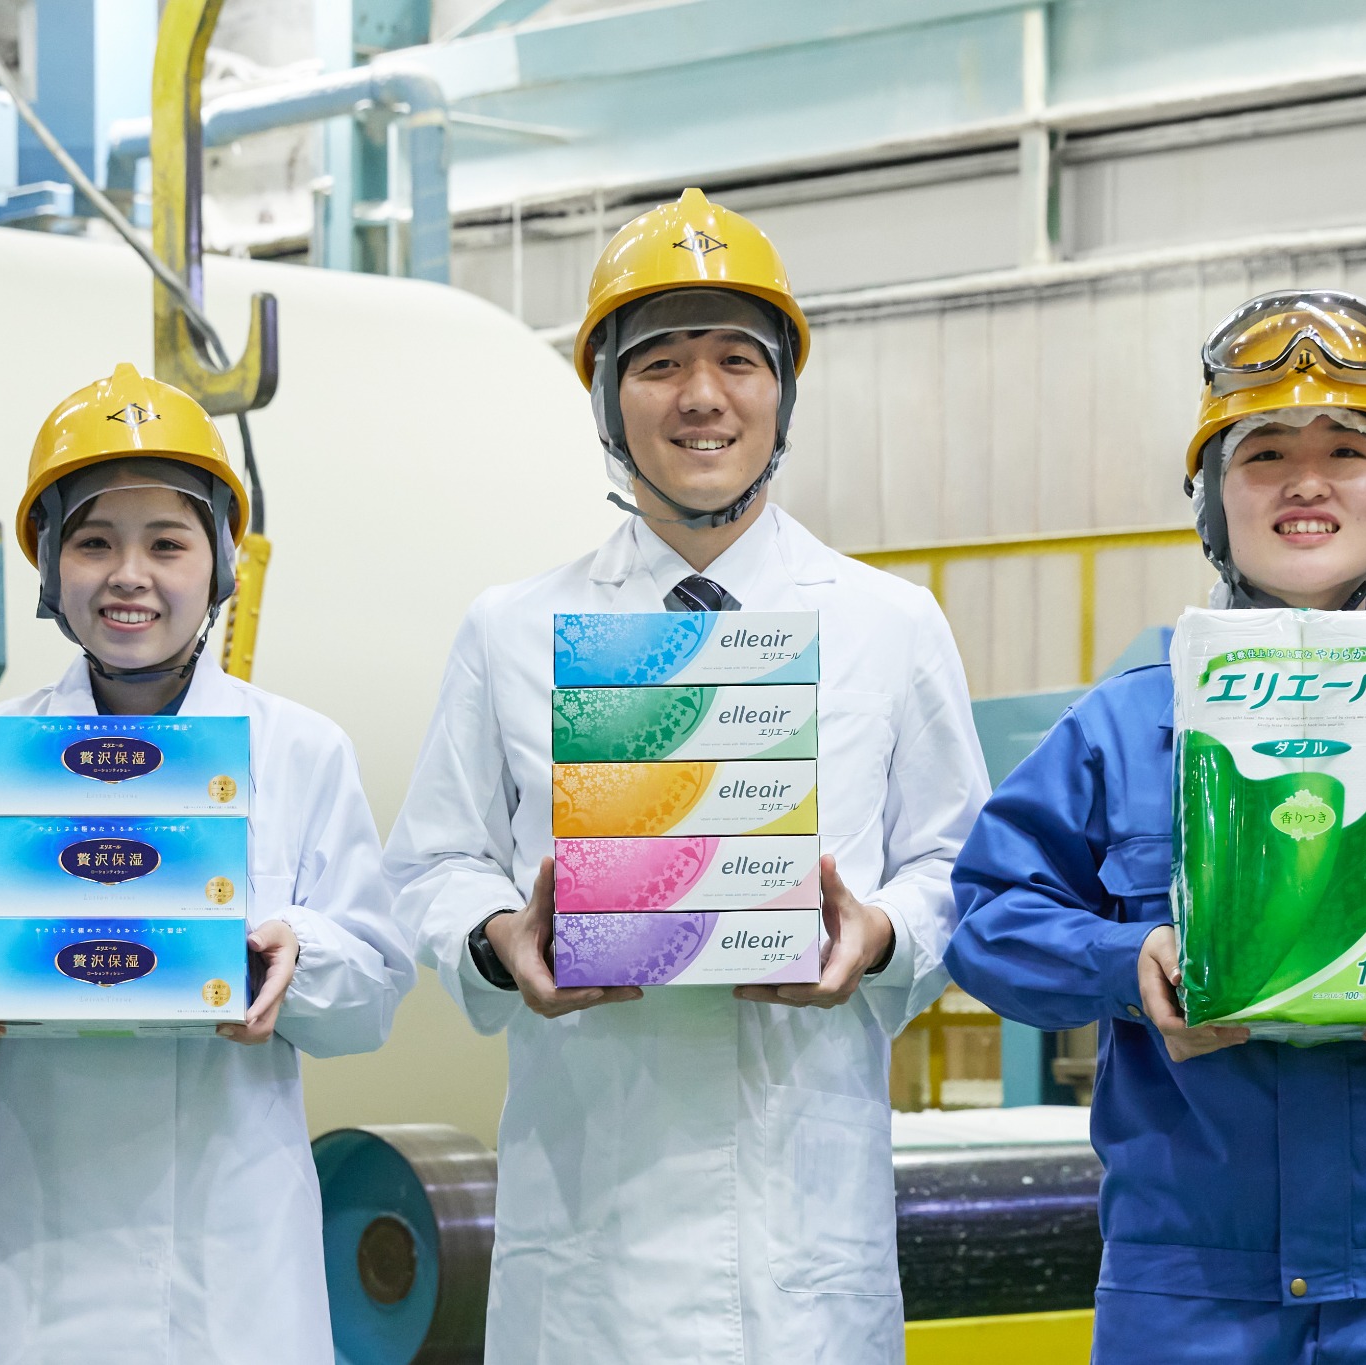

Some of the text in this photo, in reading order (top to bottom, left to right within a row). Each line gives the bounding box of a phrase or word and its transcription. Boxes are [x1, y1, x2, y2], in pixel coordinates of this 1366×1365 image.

[720, 629, 793, 648] elleair
[759, 652, 801, 661] エリエール
[718, 705, 791, 724] elleair
[758, 728, 800, 737] エリエール
[1274, 741, 1328, 755] ダブル
[79, 751, 146, 765] 贅沢保湿
[719, 780, 791, 799] elleair
[758, 803, 800, 812] エリエール
[1280, 811, 1327, 824] 香りつき
[77, 852, 143, 867] 贅沢保湿
[721, 856, 794, 875] elleair
[761, 879, 802, 888] エリエール
[721, 930, 794, 949] elleair
[73, 954, 139, 968] 贅沢保湿
[761, 953, 802, 962] エリエール
